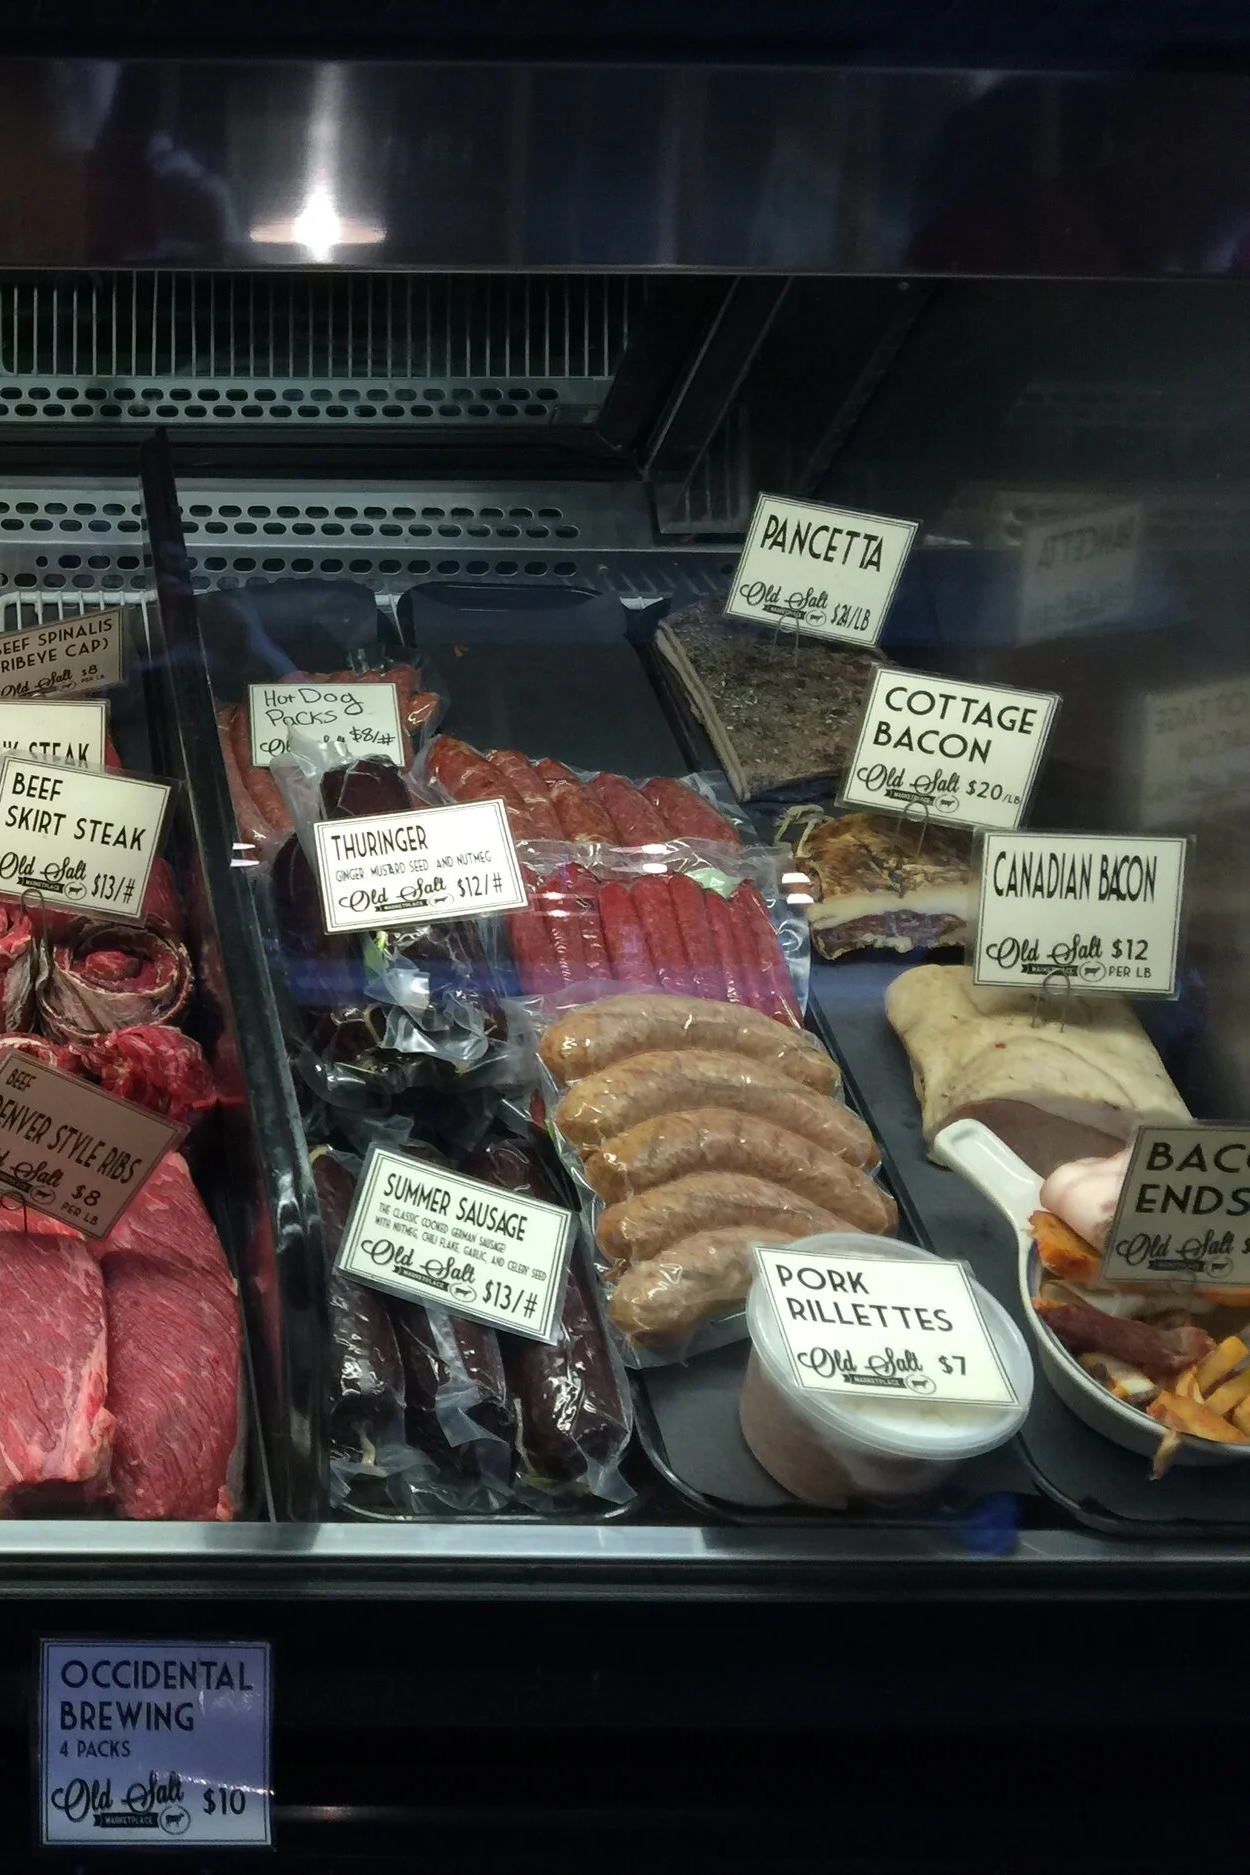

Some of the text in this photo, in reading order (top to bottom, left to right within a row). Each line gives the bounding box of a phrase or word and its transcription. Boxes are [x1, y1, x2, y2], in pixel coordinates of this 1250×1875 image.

[760, 514, 884, 572] PANCETTA
[739, 581, 782, 606] Old
[784, 587, 829, 610] Salt
[38, 618, 112, 647] SPINALIS
[65, 637, 109, 657] CAP)
[264, 688, 364, 716] Hot Dog
[885, 686, 1038, 735] COTTAGE
[873, 721, 992, 764] BACON
[12, 772, 63, 801] BEEF
[857, 764, 905, 791] Old
[909, 768, 960, 796] Salt
[5, 805, 146, 852] SKIRT STEAK
[331, 825, 429, 861] THURINGER
[40, 856, 87, 882] Salt
[410, 859, 429, 873] SEED
[436, 855, 454, 869] AND
[457, 850, 492, 866] NUTMEG
[993, 850, 1158, 903] CANADIAN BACON
[338, 889, 389, 913] Old
[396, 877, 447, 902] Salt
[986, 933, 1149, 969] Old Salt $12
[1108, 966, 1152, 978] PER LB
[5, 1068, 36, 1092] BEEF
[47, 1125, 106, 1168] STYLE
[97, 1146, 142, 1184] RIBS
[10, 1161, 64, 1189] Salt
[71, 1184, 101, 1207] $8
[1135, 1183, 1250, 1217] ENDS
[61, 1202, 99, 1226] PER LB
[379, 1202, 391, 1215] THE
[392, 1206, 418, 1224] CLASSIC
[421, 1216, 448, 1234] COOKED
[383, 1173, 528, 1242] SUMMER SAUSAGE
[361, 1238, 414, 1266] Old
[419, 1257, 476, 1284] Salt
[375, 1215, 391, 1229] WITH
[490, 1255, 505, 1269] AND
[531, 1267, 547, 1282] SEED
[1116, 1233, 1172, 1266] Old
[1177, 1229, 1235, 1260] Salt
[775, 1264, 870, 1294] PORK
[786, 1297, 954, 1332] RILLETTES
[797, 1346, 967, 1378] Old Salt $7
[61, 1660, 254, 1691] OCCIDENTAL
[60, 1701, 194, 1731] BREWING
[59, 1740, 131, 1758] 4 PACKS
[51, 1769, 246, 1823] Old Salt $10
